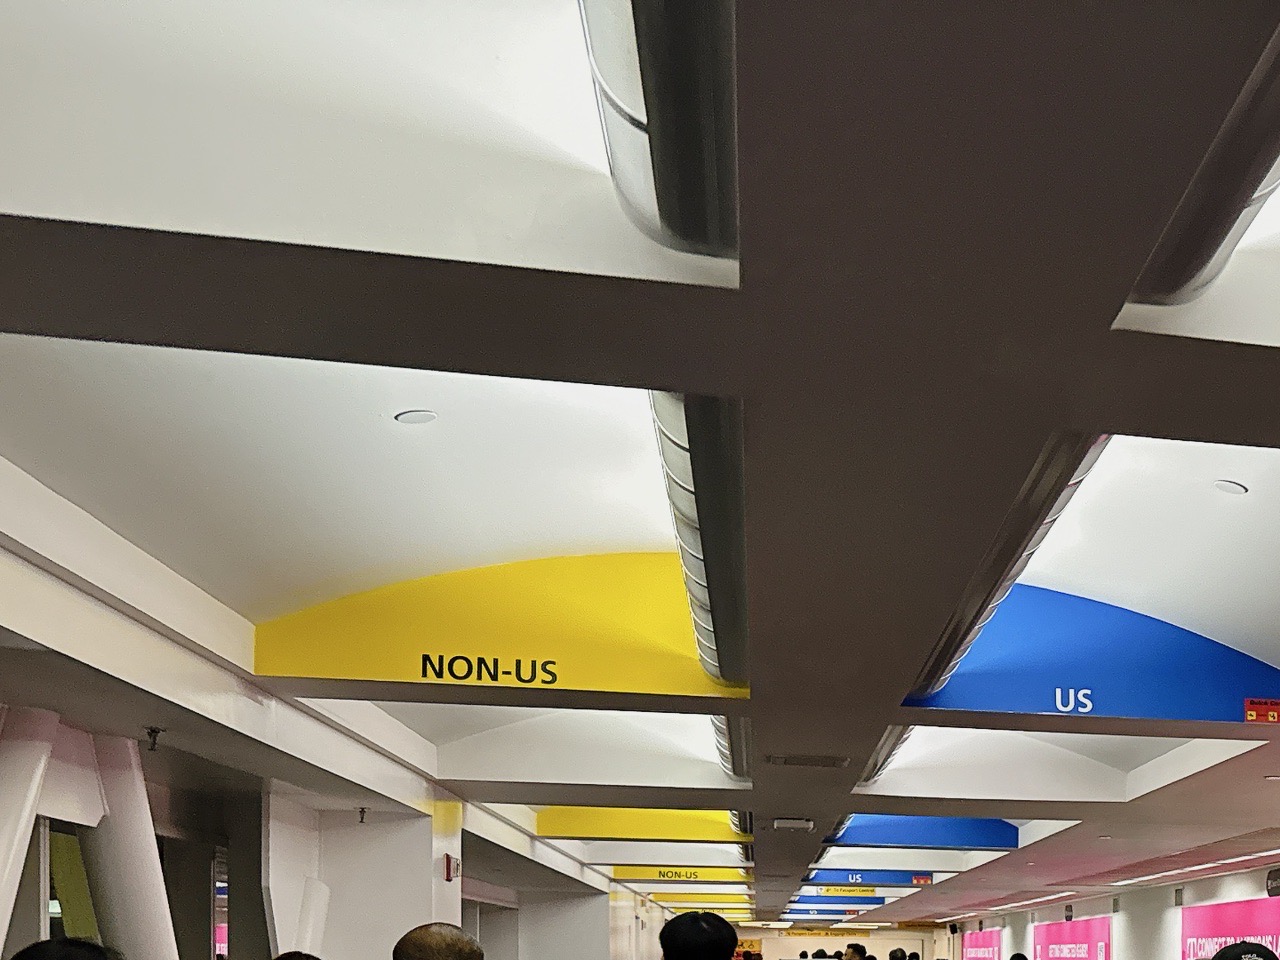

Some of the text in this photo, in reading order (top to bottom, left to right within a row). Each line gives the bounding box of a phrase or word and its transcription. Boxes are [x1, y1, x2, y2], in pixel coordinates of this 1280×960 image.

[421, 653, 558, 685] NON-US
[1055, 687, 1093, 713] US
[658, 870, 698, 879] NON-US
[848, 874, 862, 883] US
